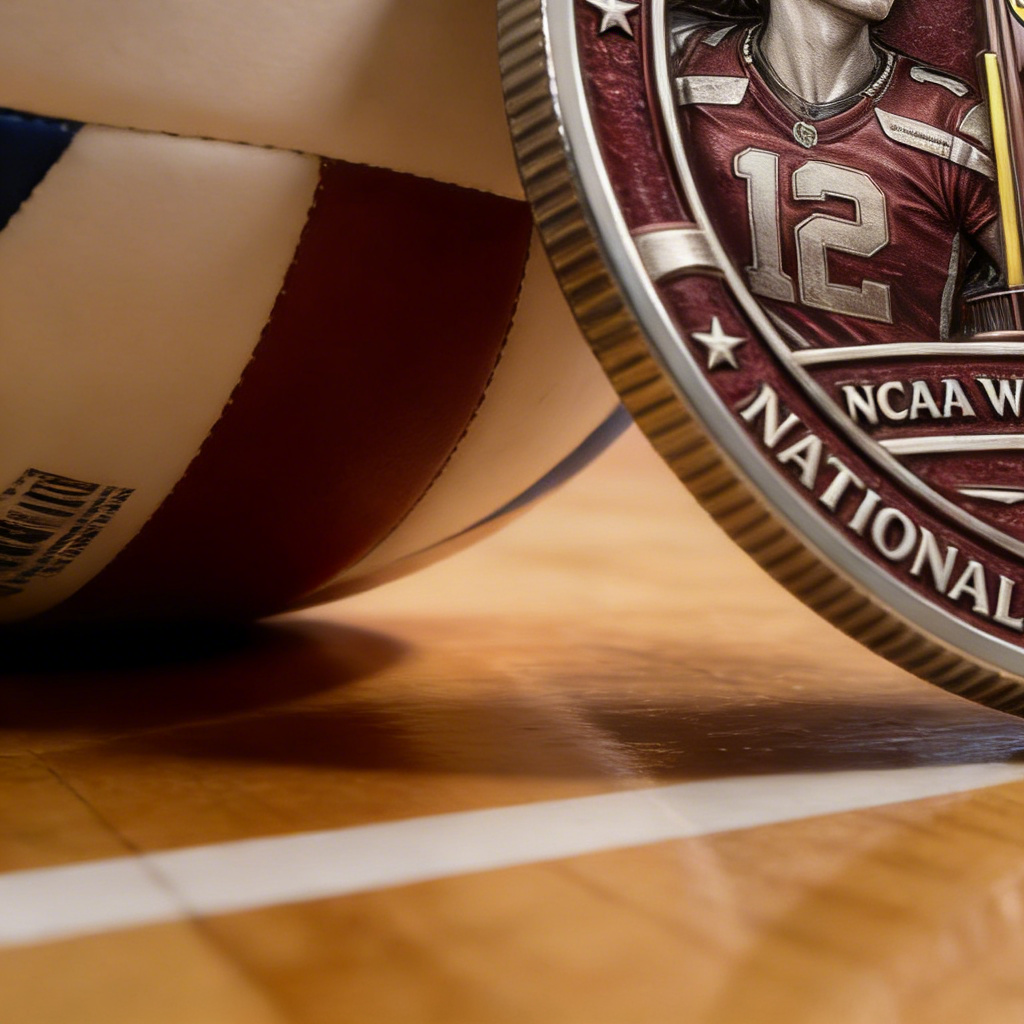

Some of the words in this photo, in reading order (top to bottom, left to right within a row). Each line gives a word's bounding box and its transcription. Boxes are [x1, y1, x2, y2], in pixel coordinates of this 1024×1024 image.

[734, 146, 893, 324] 12
[843, 379, 975, 425] NCAA
[741, 386, 1024, 632] NATIONAL
